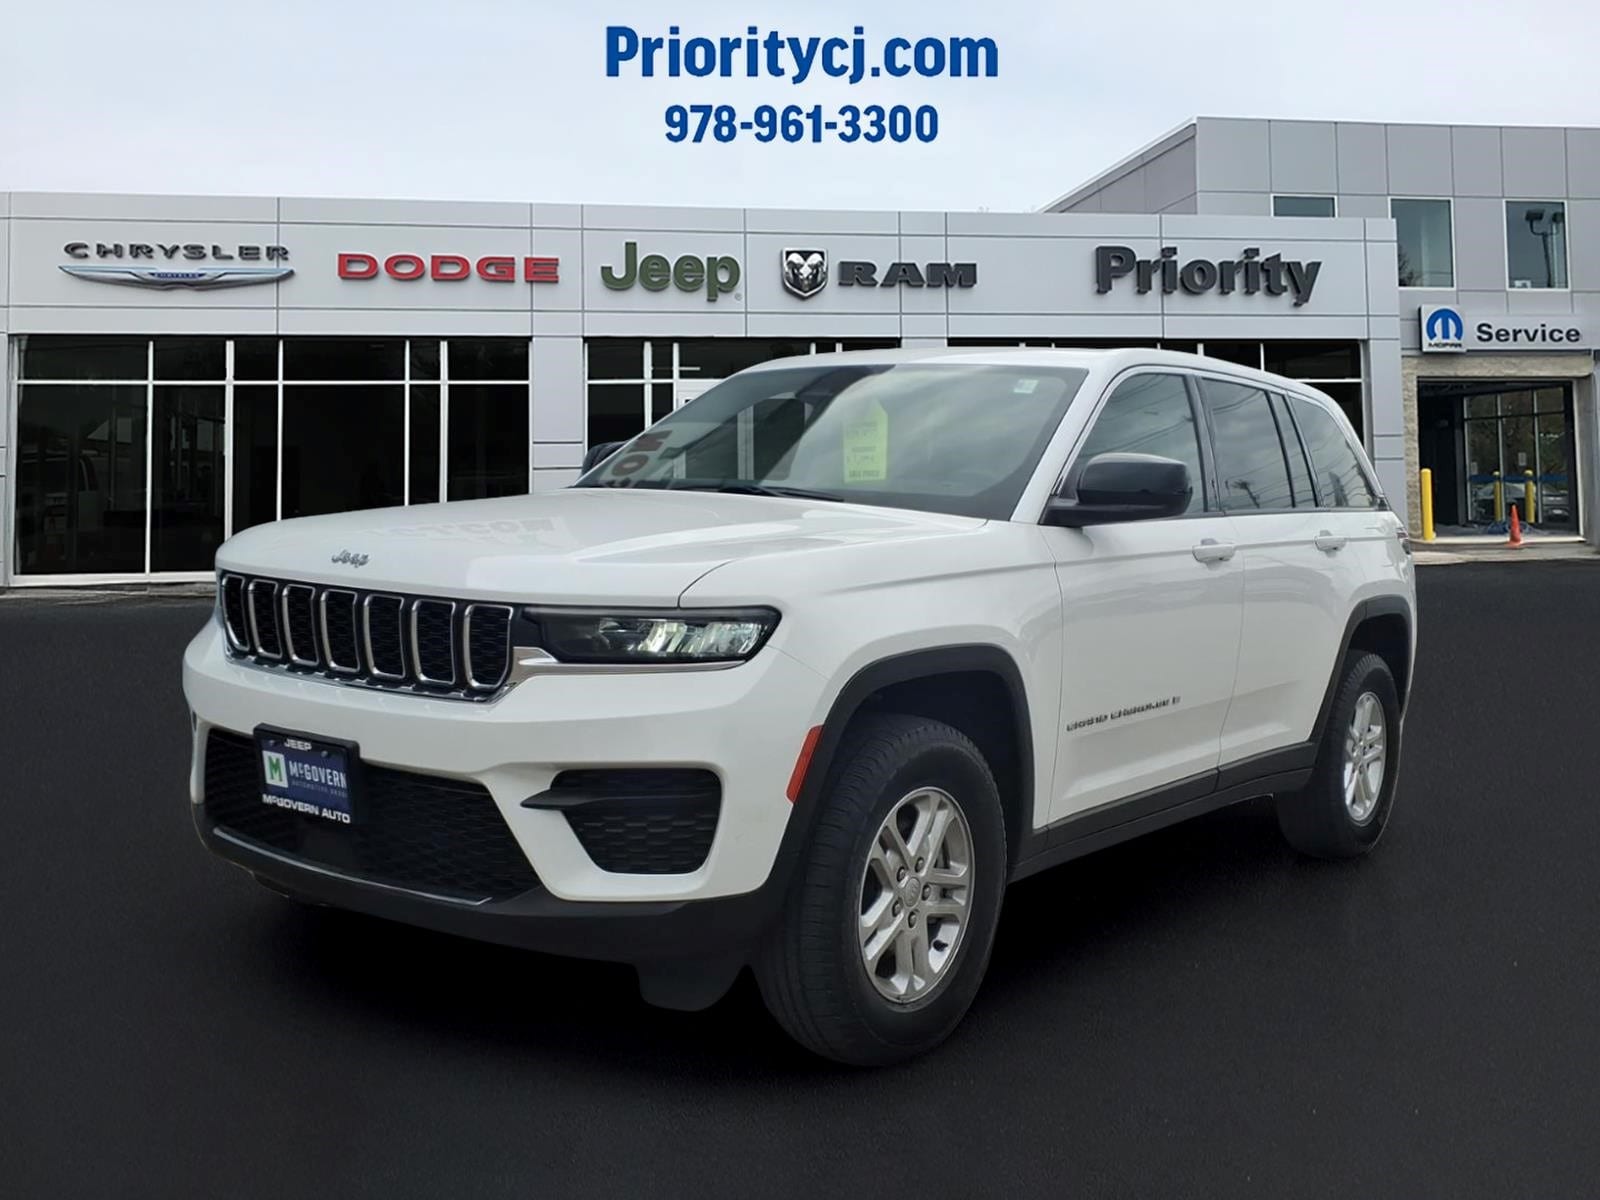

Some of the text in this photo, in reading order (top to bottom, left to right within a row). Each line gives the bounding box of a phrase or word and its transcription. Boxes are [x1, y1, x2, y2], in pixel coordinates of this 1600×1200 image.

[64, 242, 289, 260] CHRYSLER
[338, 253, 559, 283] DODGE
[601, 242, 740, 301] Jeep
[838, 261, 977, 287] RAM
[1096, 245, 1322, 307] Priority
[1476, 323, 1580, 343] Service
[284, 738, 312, 751] JEEP
[321, 808, 351, 824] AUTO
